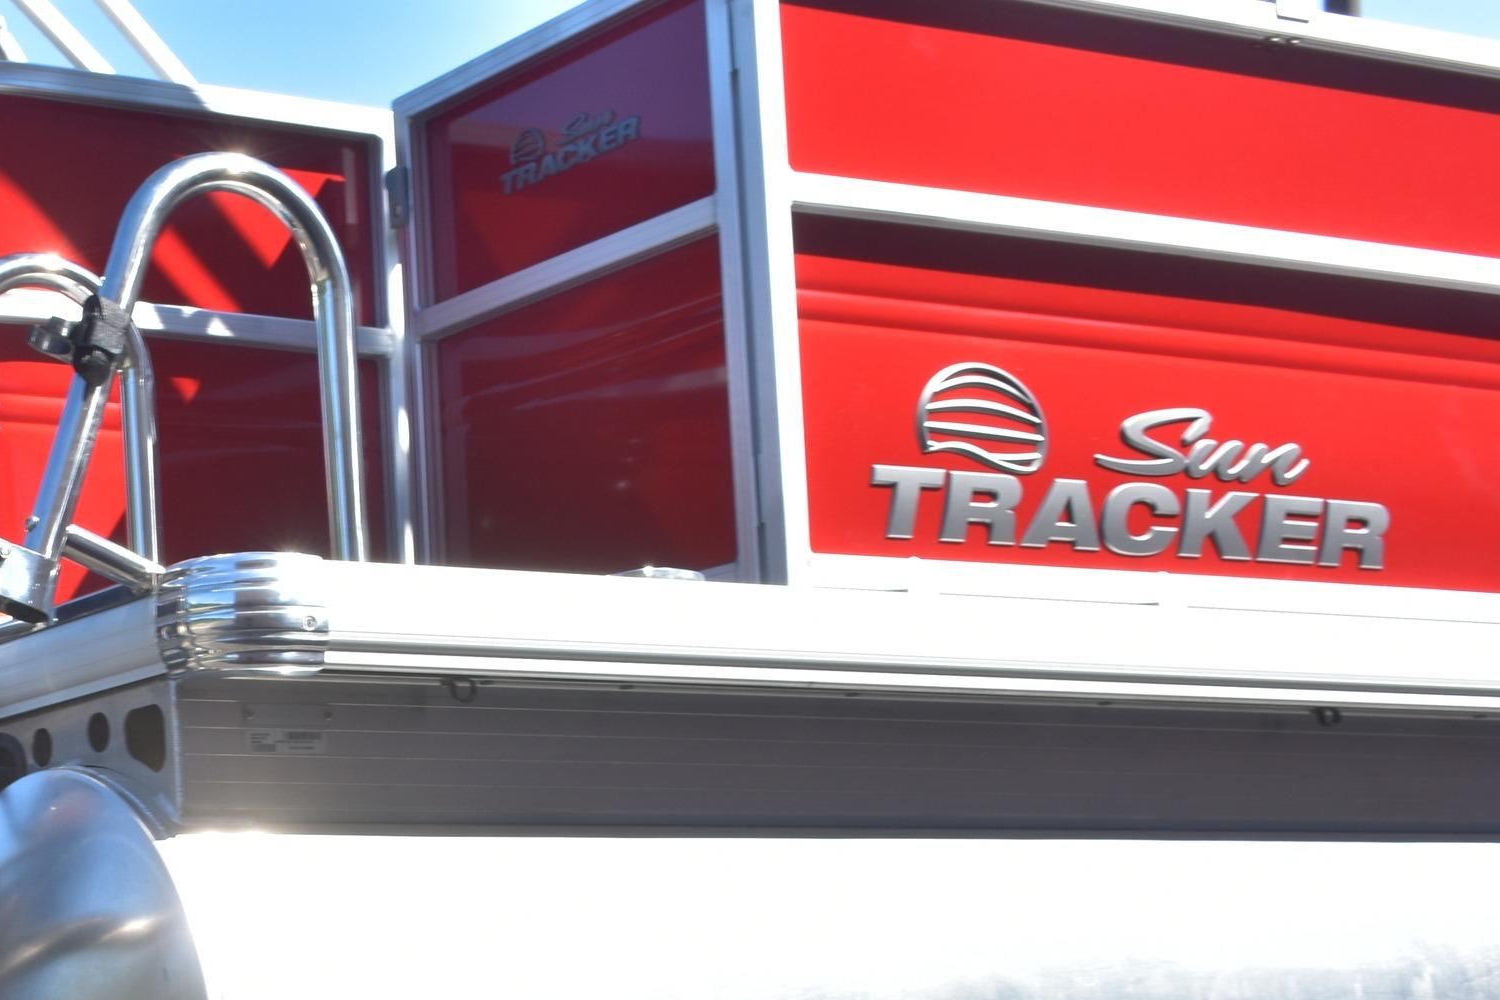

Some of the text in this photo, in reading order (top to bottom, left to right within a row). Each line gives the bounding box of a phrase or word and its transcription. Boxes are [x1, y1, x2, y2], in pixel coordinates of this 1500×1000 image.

[500, 114, 641, 195] TRACKER
[1094, 408, 1310, 486] Sun
[871, 464, 1391, 570] TRACKER
